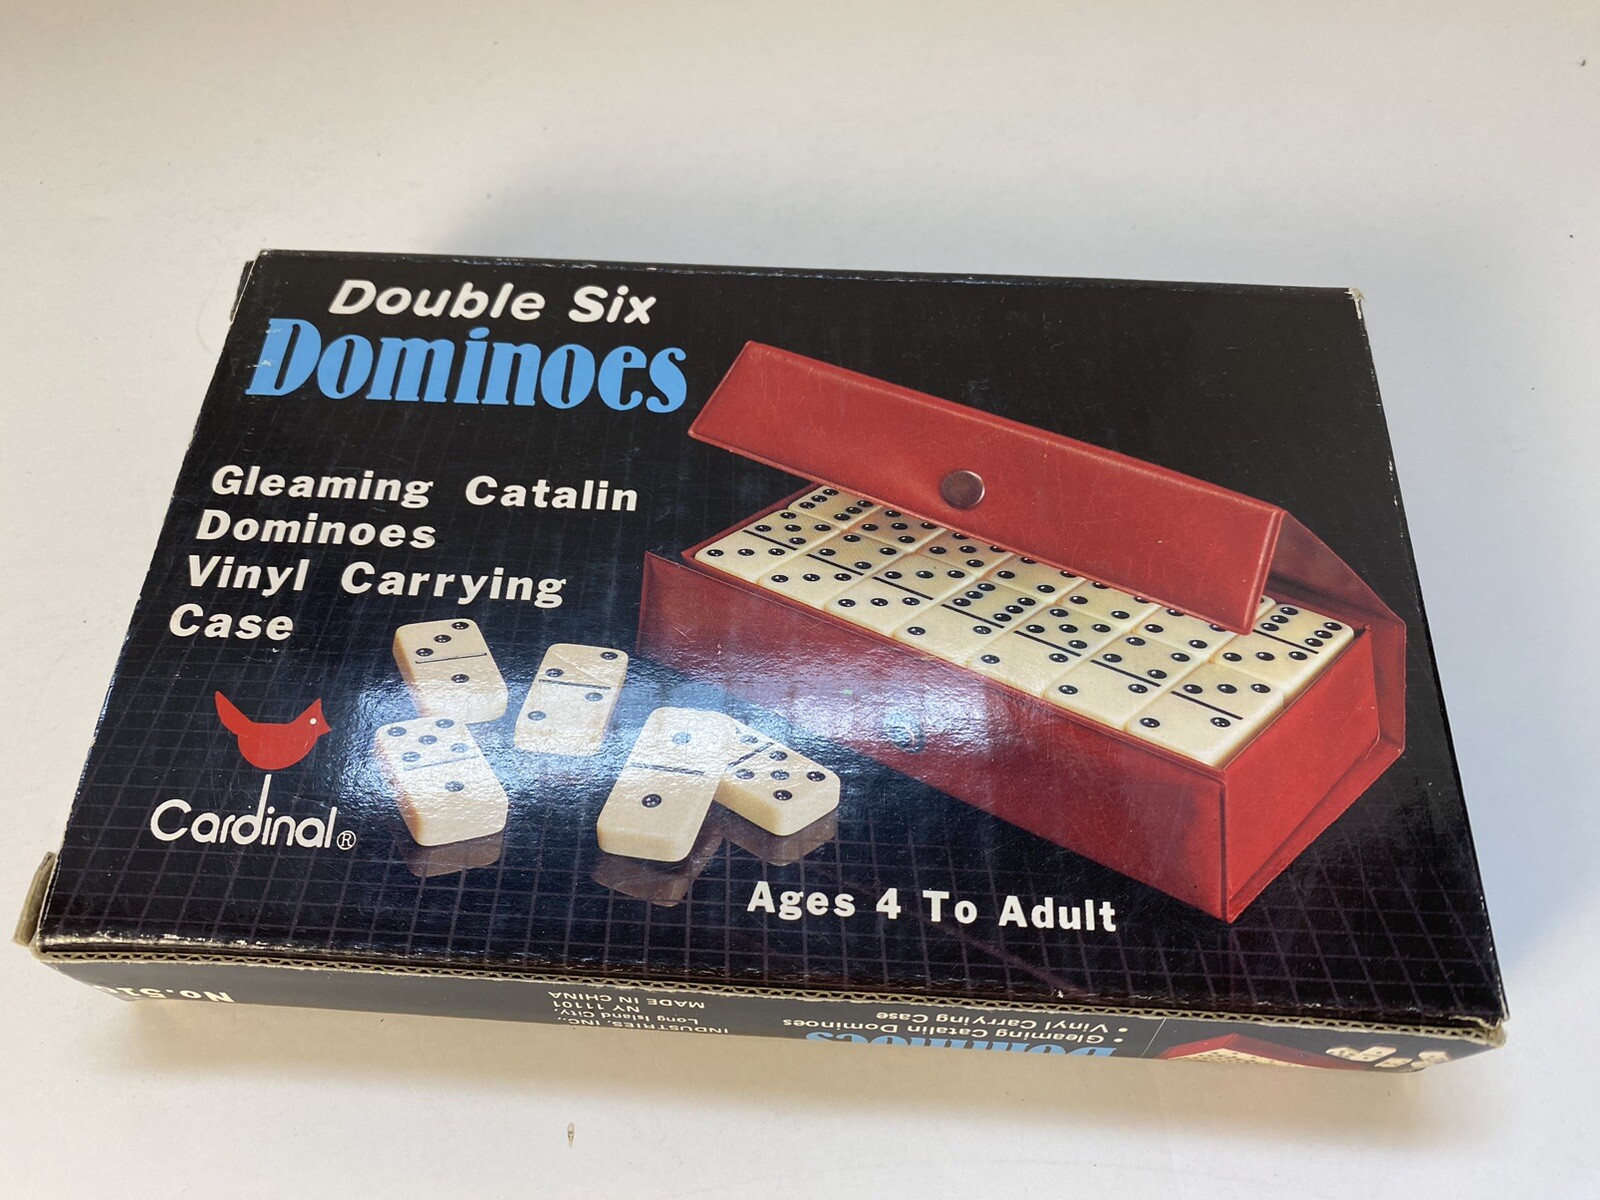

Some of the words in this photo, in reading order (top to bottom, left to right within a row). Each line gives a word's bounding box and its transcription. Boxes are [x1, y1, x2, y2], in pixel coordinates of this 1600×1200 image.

[329, 279, 546, 321] Double
[568, 286, 657, 325] Six
[245, 317, 688, 414] Dominoes
[211, 465, 434, 509] Gleaming
[465, 475, 638, 511] Catalin
[196, 508, 437, 549] Dominoes
[188, 554, 311, 597] Vinyl
[341, 561, 567, 608] Carrying
[169, 603, 294, 640] Case
[747, 880, 856, 921] Ages
[876, 887, 902, 919] 4
[923, 889, 978, 924] To
[999, 895, 1117, 932] Adult
[548, 991, 612, 1002] CHINA
[619, 996, 639, 1005] IN
[646, 998, 706, 1009] MADE
[553, 1001, 605, 1010] 11101
[613, 1005, 640, 1013] NY
[554, 1008, 595, 1018] City,
[601, 1012, 650, 1022] Island
[656, 1015, 699, 1025] Long
[875, 1011, 930, 1024] Case
[782, 1018, 899, 1033] Dominoes
[936, 1013, 1036, 1030] Carrying
[1045, 1021, 1109, 1033] Vinyl
[907, 1025, 988, 1039] Catalin
[996, 1029, 1105, 1044] Gleaming
